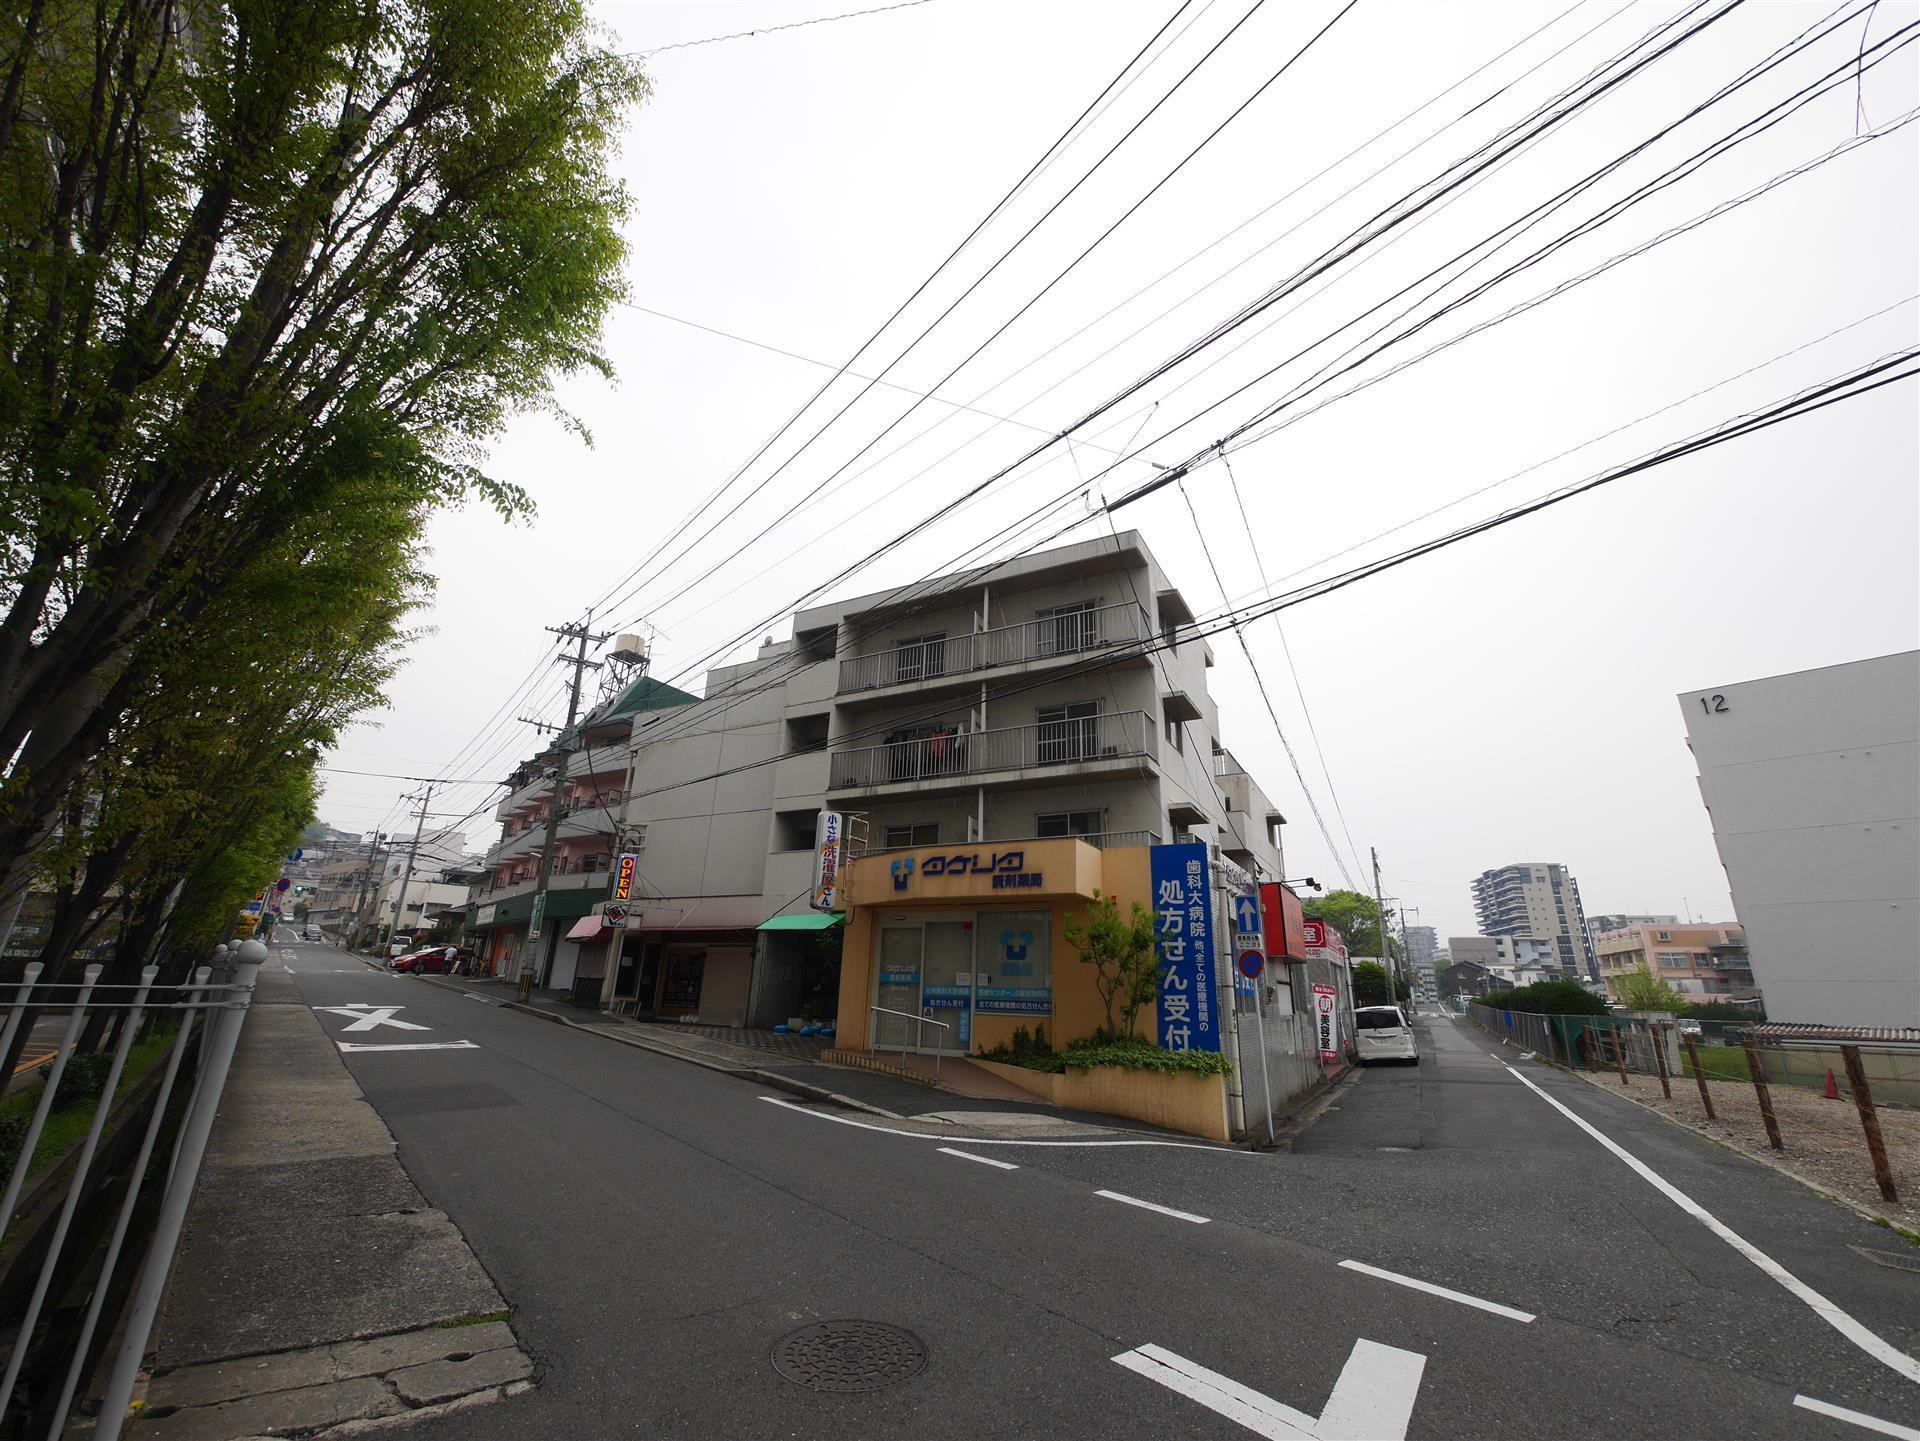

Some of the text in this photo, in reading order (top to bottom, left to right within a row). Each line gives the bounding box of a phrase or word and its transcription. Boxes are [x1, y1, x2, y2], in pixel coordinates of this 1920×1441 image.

[1700, 694, 1729, 715] 12
[616, 858, 633, 898] OPEN
[820, 814, 838, 906] 小さな洗濯屋さん
[1158, 879, 1192, 1051] 処方せん受付
